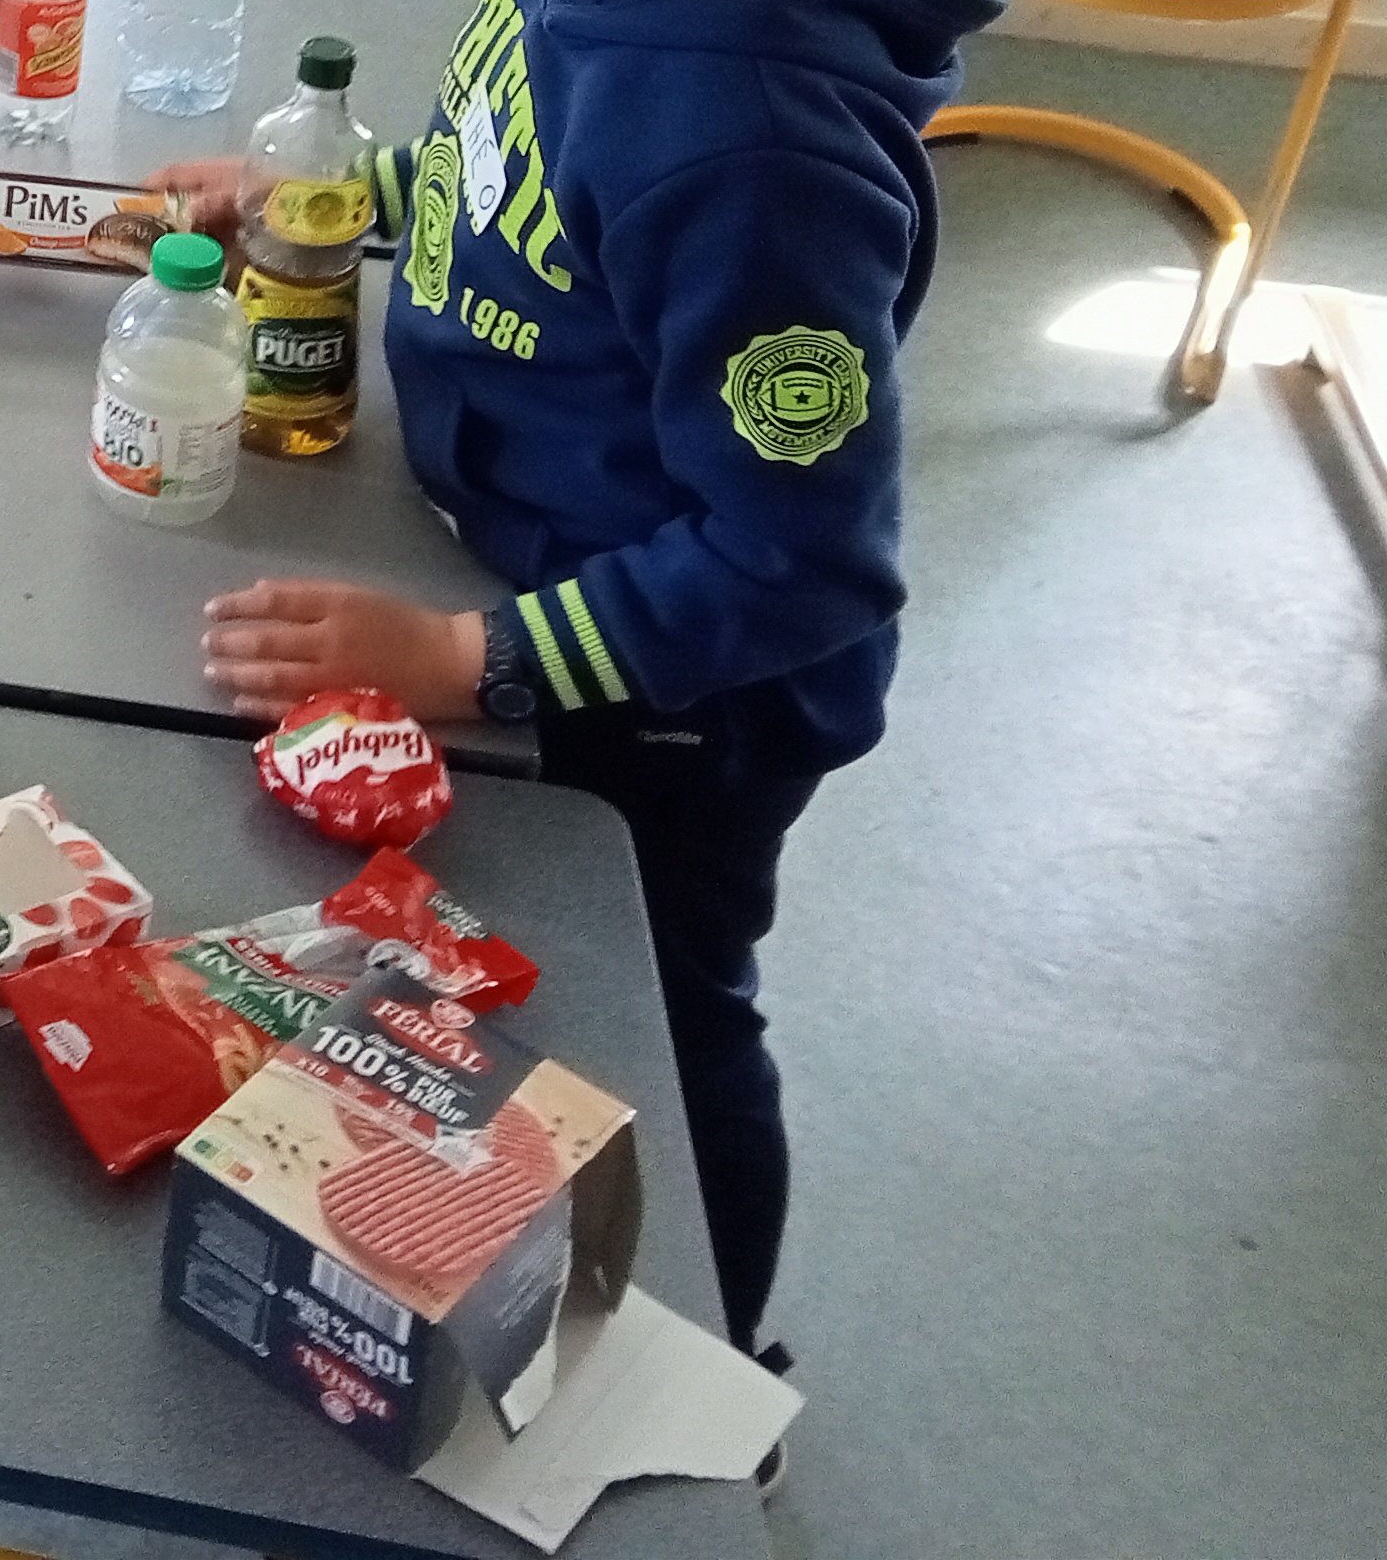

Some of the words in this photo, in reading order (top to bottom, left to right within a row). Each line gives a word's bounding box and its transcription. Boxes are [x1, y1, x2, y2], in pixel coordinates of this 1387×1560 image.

[256, 335, 346, 367] PUGET
[460, 286, 541, 360] 1986
[755, 345, 836, 375] UNIVERSITY
[297, 727, 424, 785] Babybel
[195, 945, 320, 1030] ANZANI
